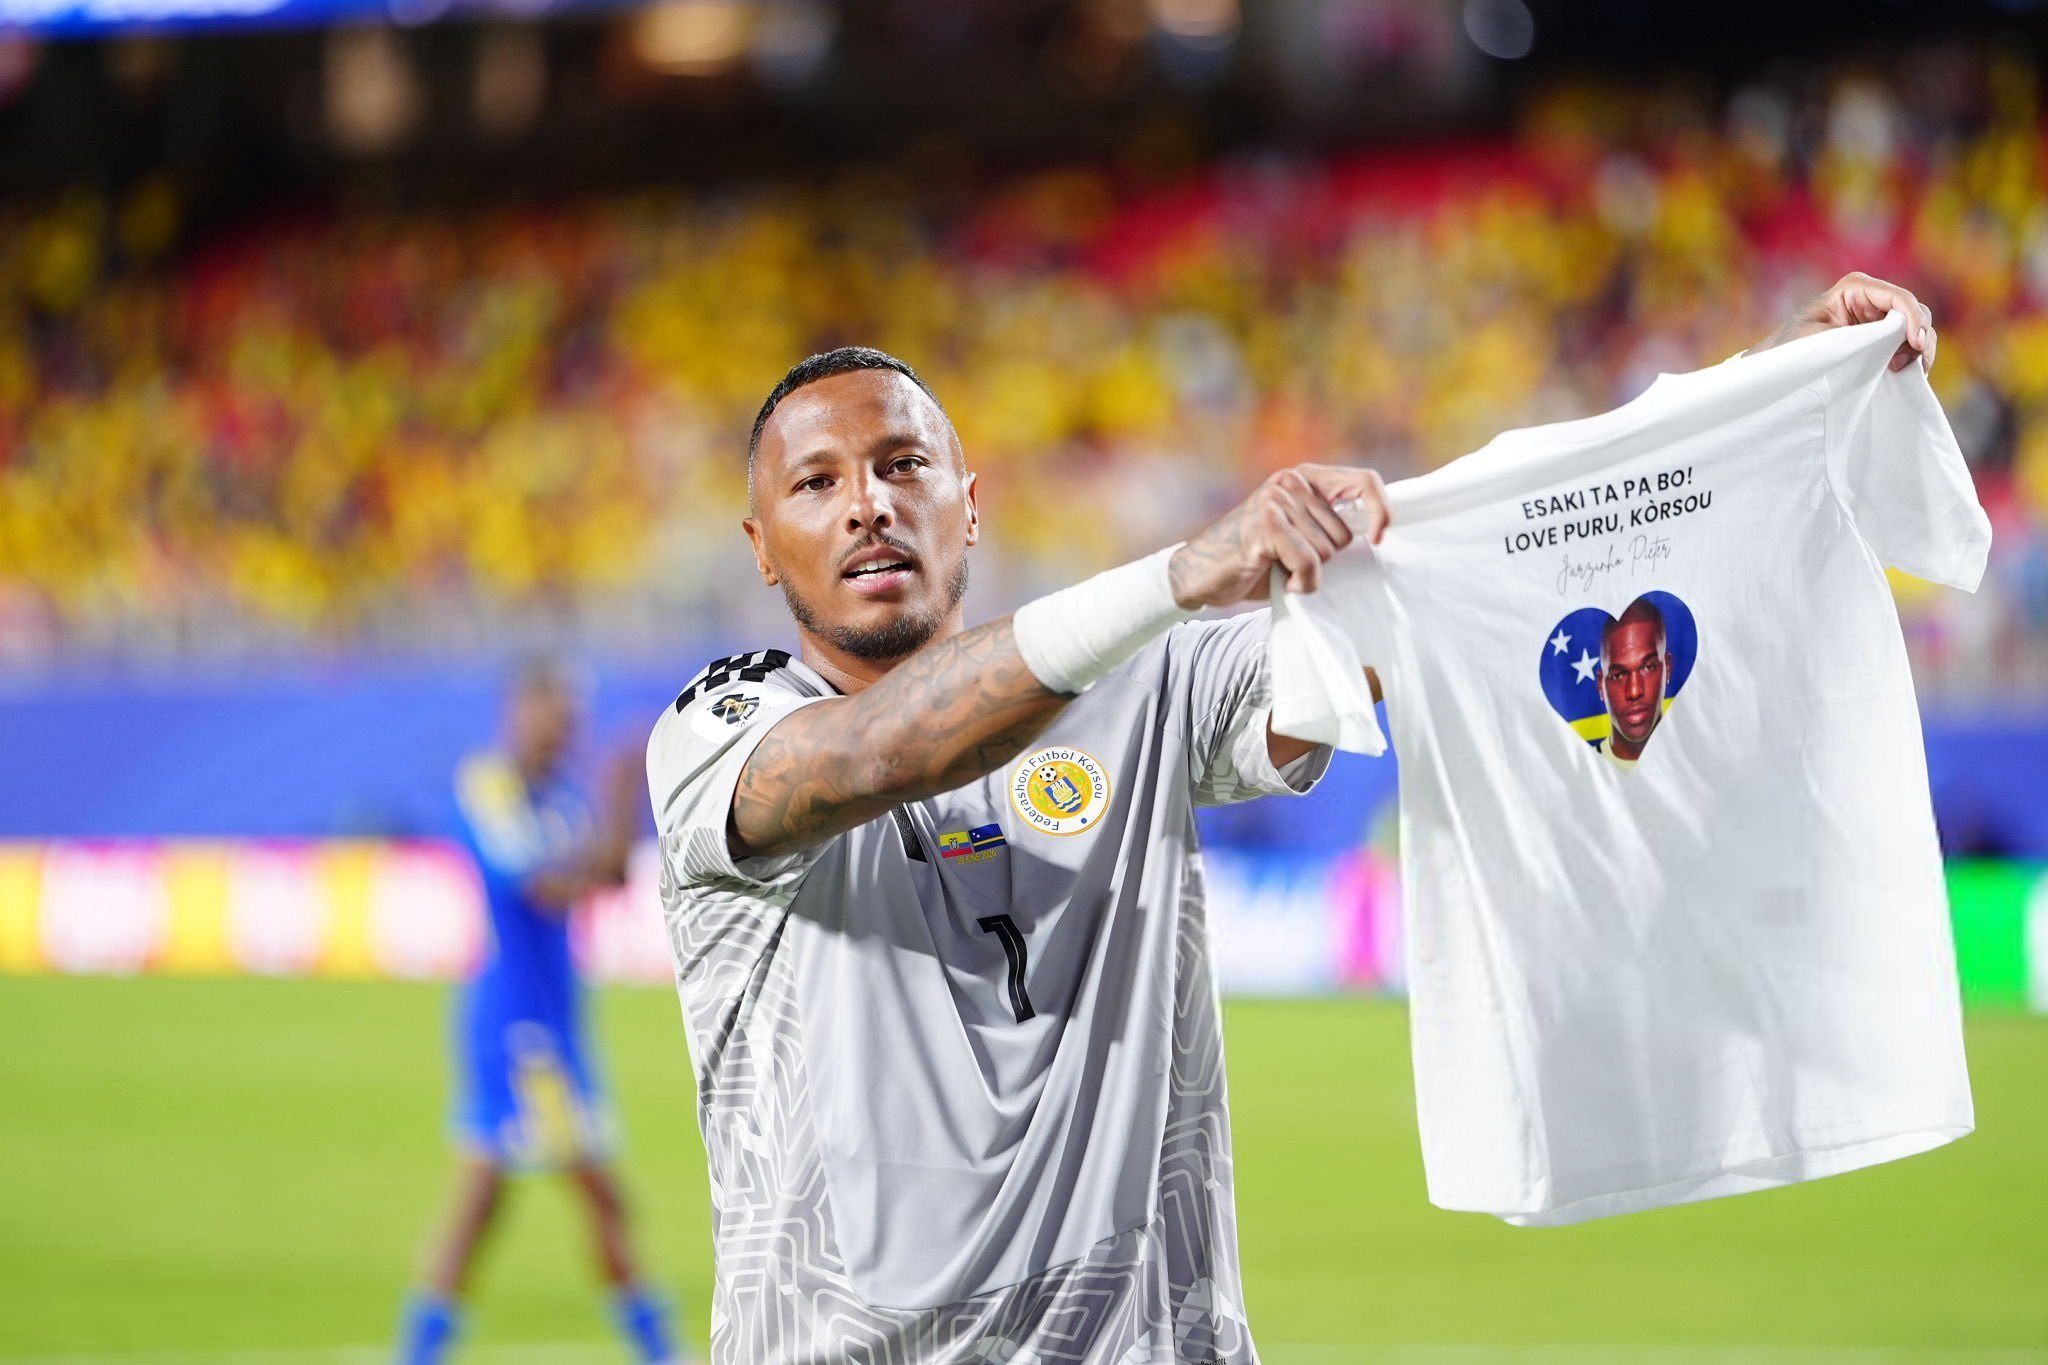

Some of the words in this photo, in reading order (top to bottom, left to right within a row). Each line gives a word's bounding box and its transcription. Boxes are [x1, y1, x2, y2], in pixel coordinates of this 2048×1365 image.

[1504, 527, 1558, 554] LOVE
[1564, 514, 1624, 542] PURU,
[1630, 491, 1712, 527] KÒRSOU
[1522, 490, 1585, 520] ESAKI
[1590, 485, 1619, 505] TA
[1623, 477, 1652, 499] PA
[1657, 466, 1692, 491] BO!
[1014, 768, 1060, 831] Federashon
[976, 913, 1036, 1024] 1
